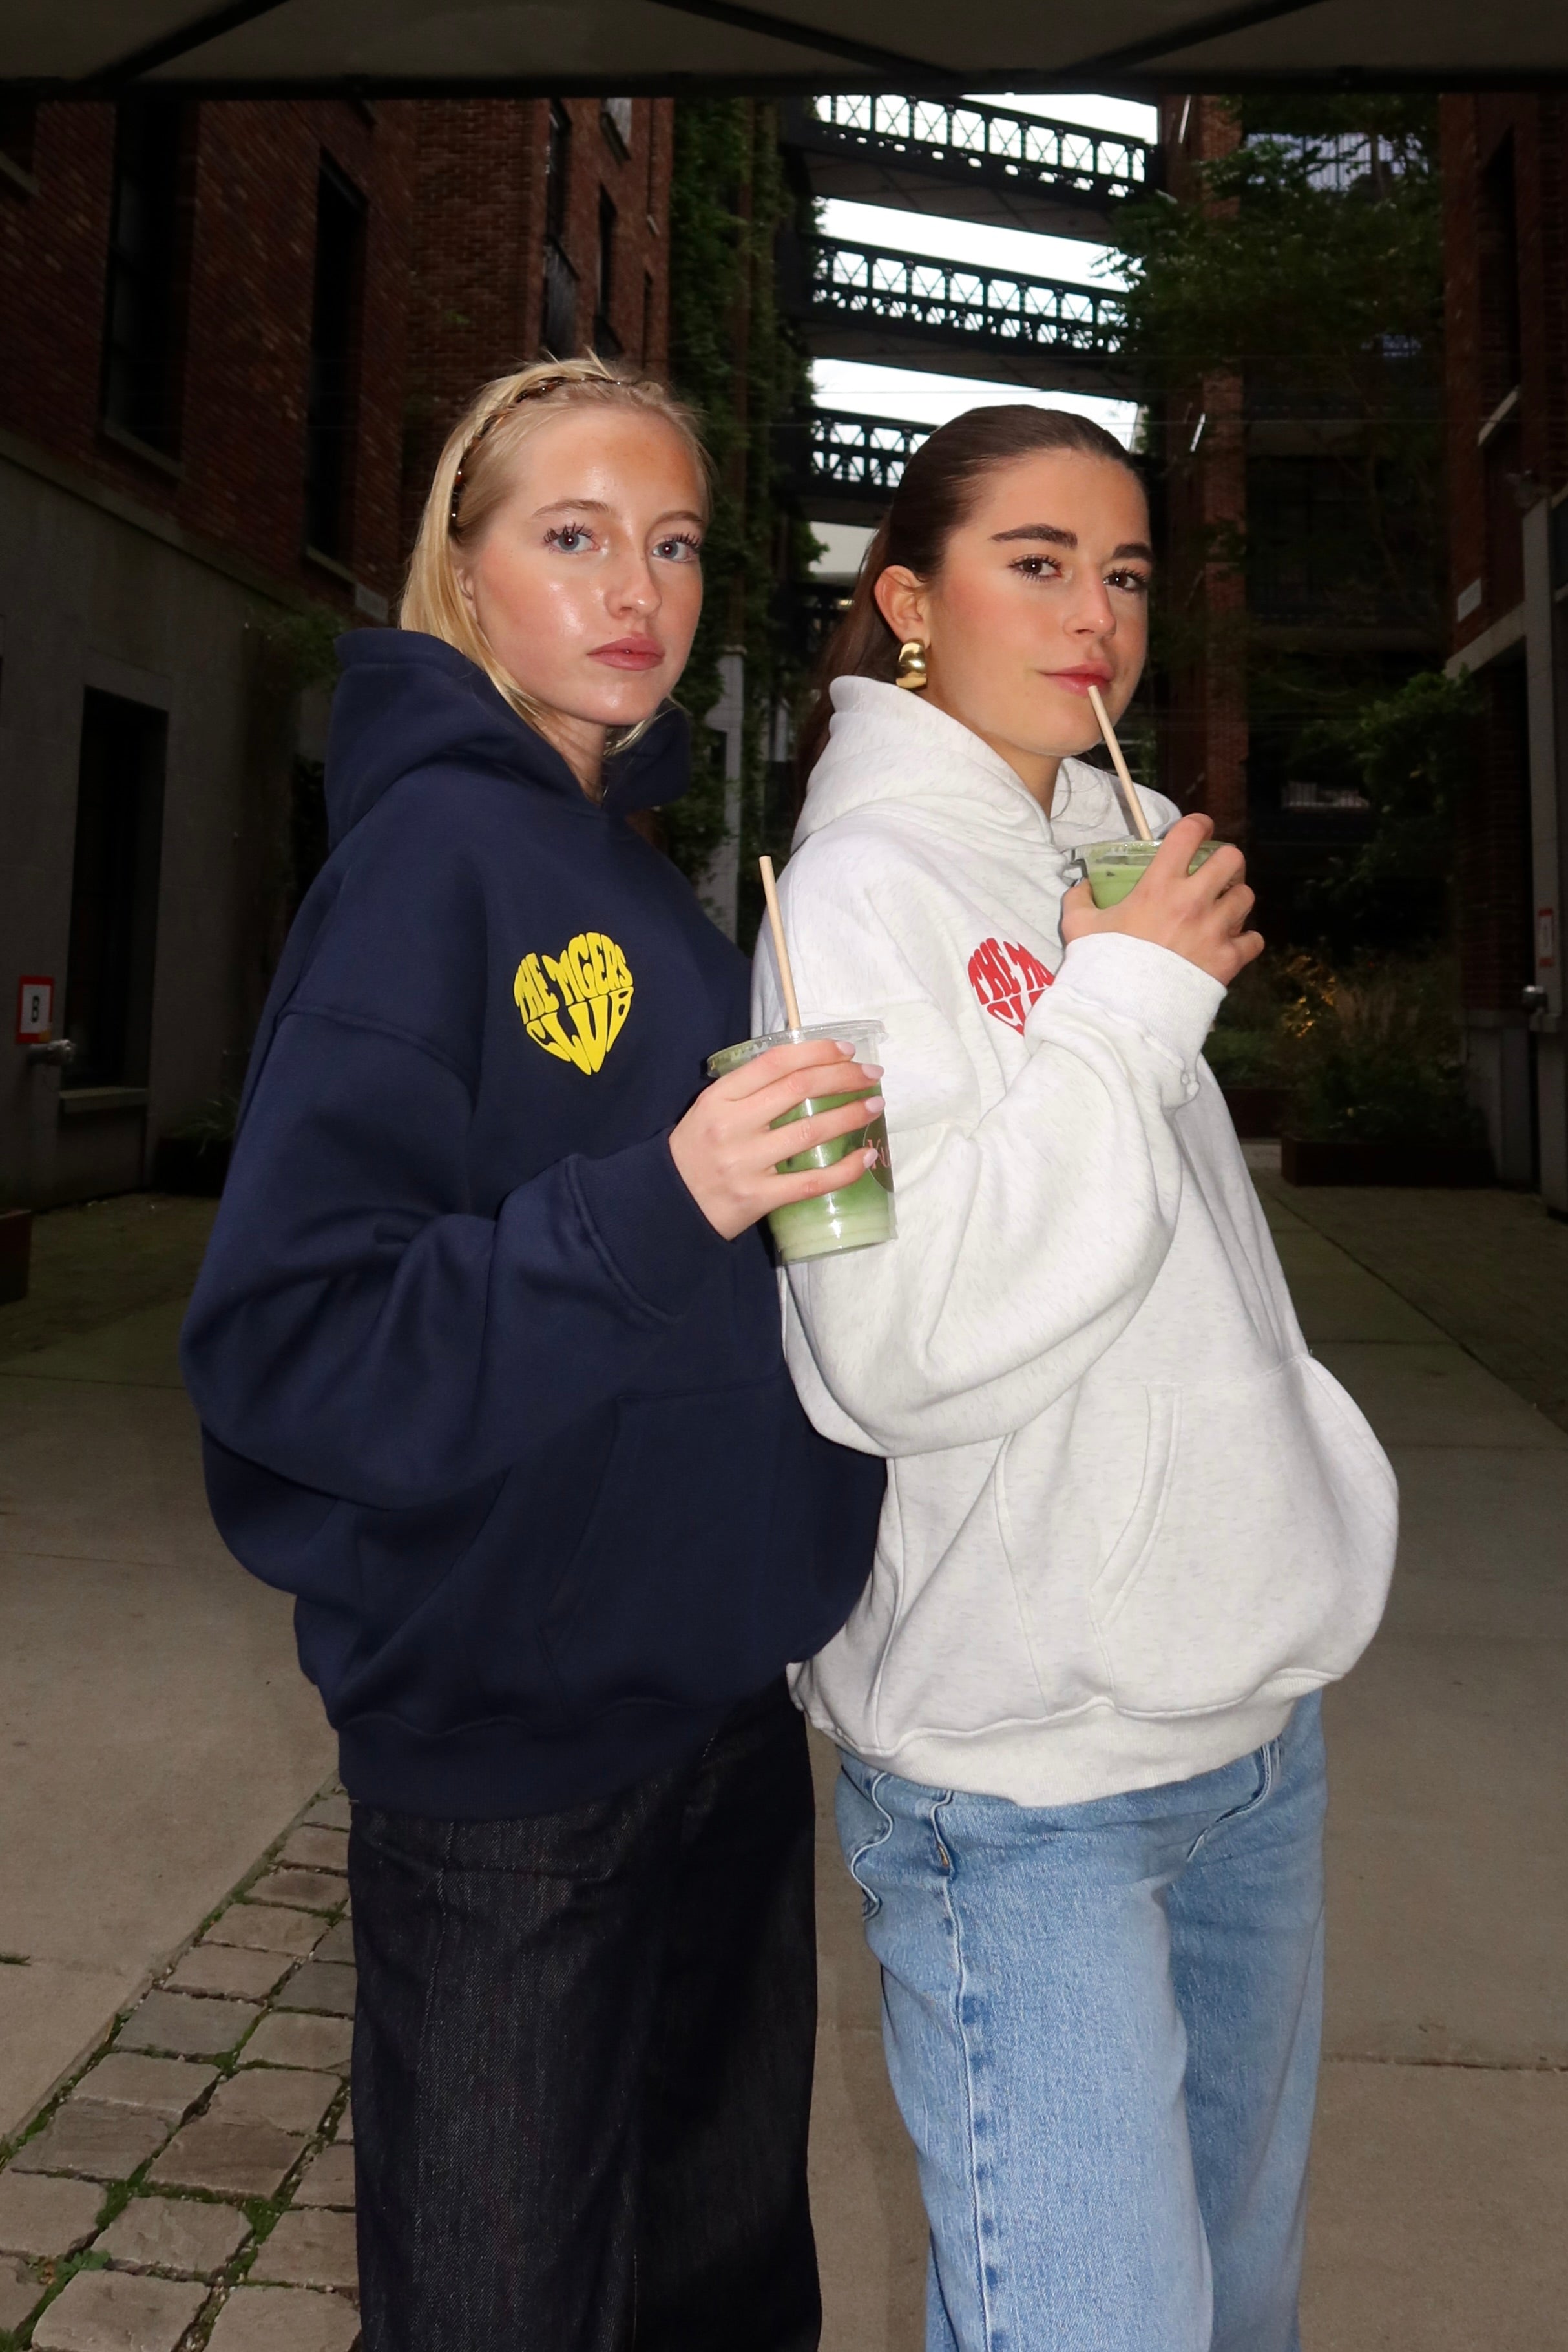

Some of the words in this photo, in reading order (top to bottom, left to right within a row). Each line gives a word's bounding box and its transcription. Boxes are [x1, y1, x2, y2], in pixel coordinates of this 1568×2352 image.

[514, 953, 559, 1025] THE
[968, 938, 1021, 1005] THE
[526, 986, 634, 1075] CLUB
